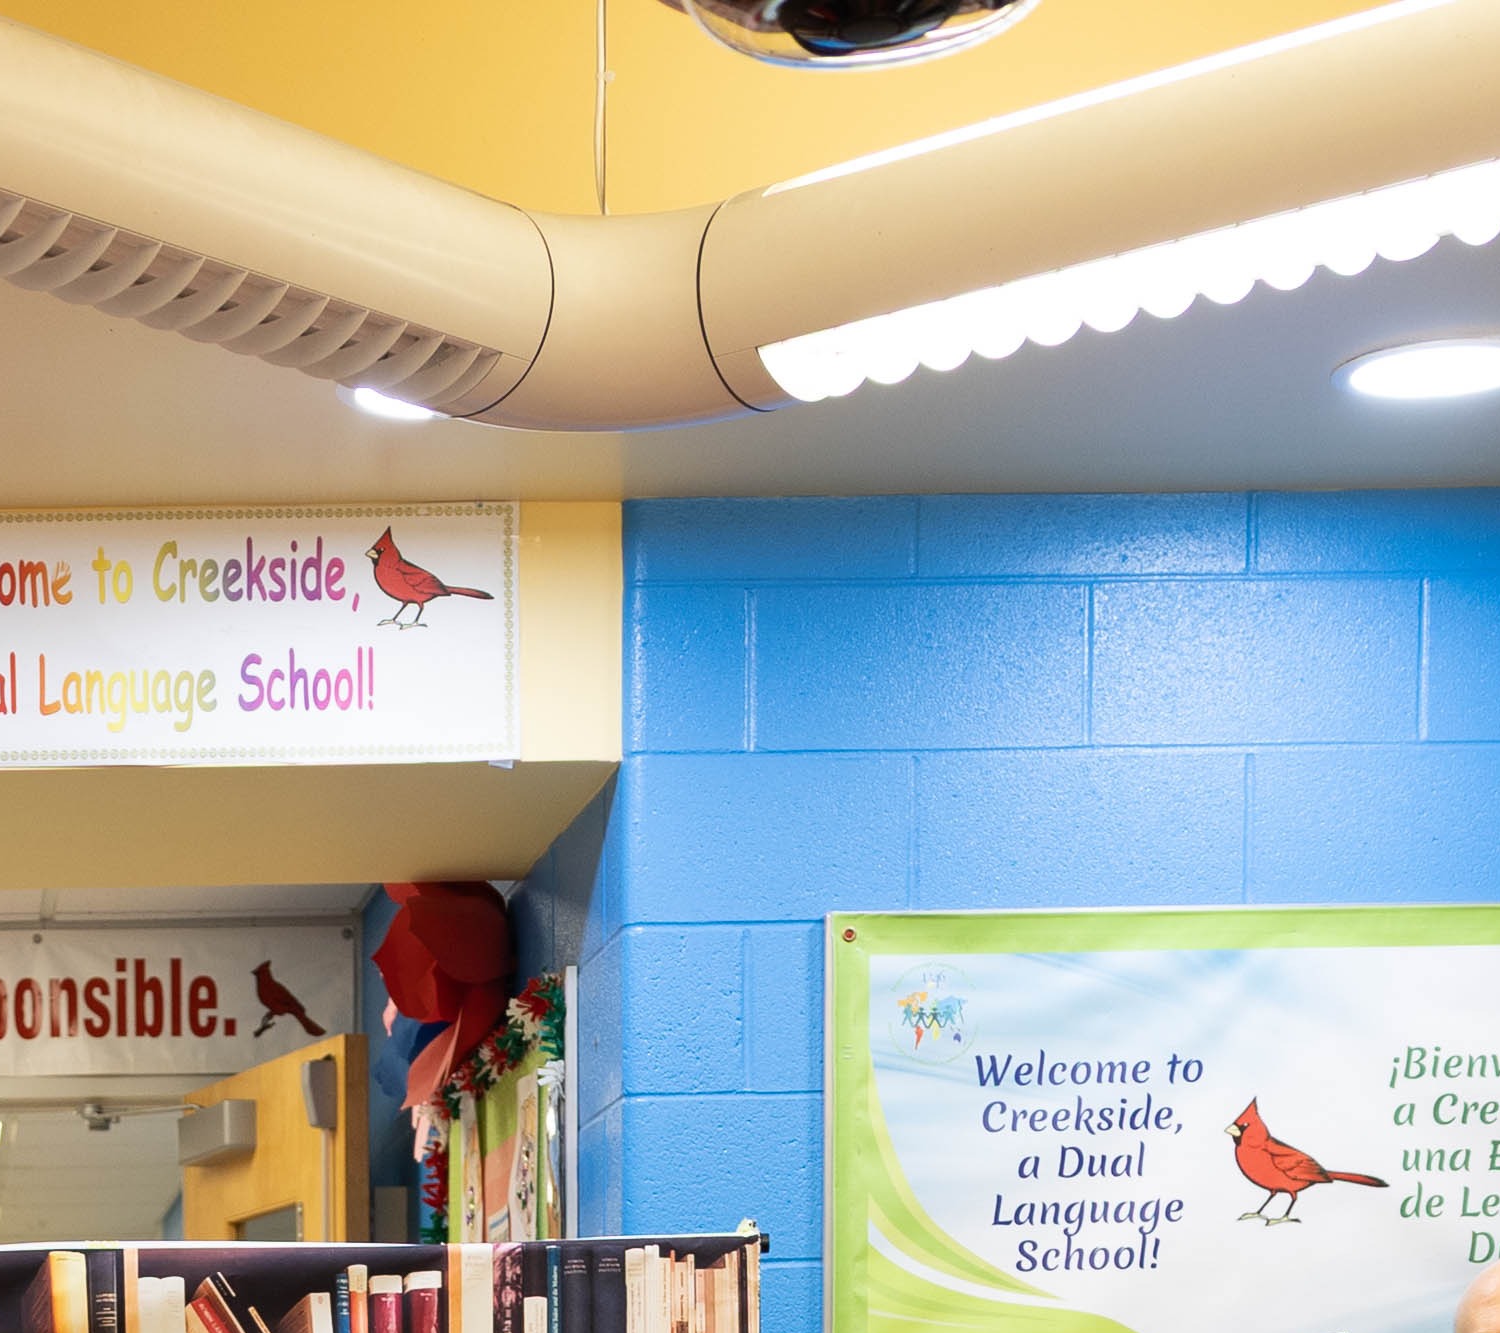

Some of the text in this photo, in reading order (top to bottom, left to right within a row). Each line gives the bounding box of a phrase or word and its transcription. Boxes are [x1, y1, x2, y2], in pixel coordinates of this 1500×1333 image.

[92, 546, 133, 605] to
[153, 536, 360, 612] Creekside,
[39, 653, 217, 732] Language
[238, 647, 374, 712] School!
[974, 1049, 1204, 1089] Welcome to
[981, 1095, 1185, 1136] Creekside,
[1393, 1097, 1416, 1125] a
[1017, 1142, 1144, 1179] a Dual
[1401, 1143, 1468, 1172] una
[991, 1194, 1184, 1236] Language
[1399, 1186, 1445, 1219] de
[1014, 1234, 1161, 1274] School!
